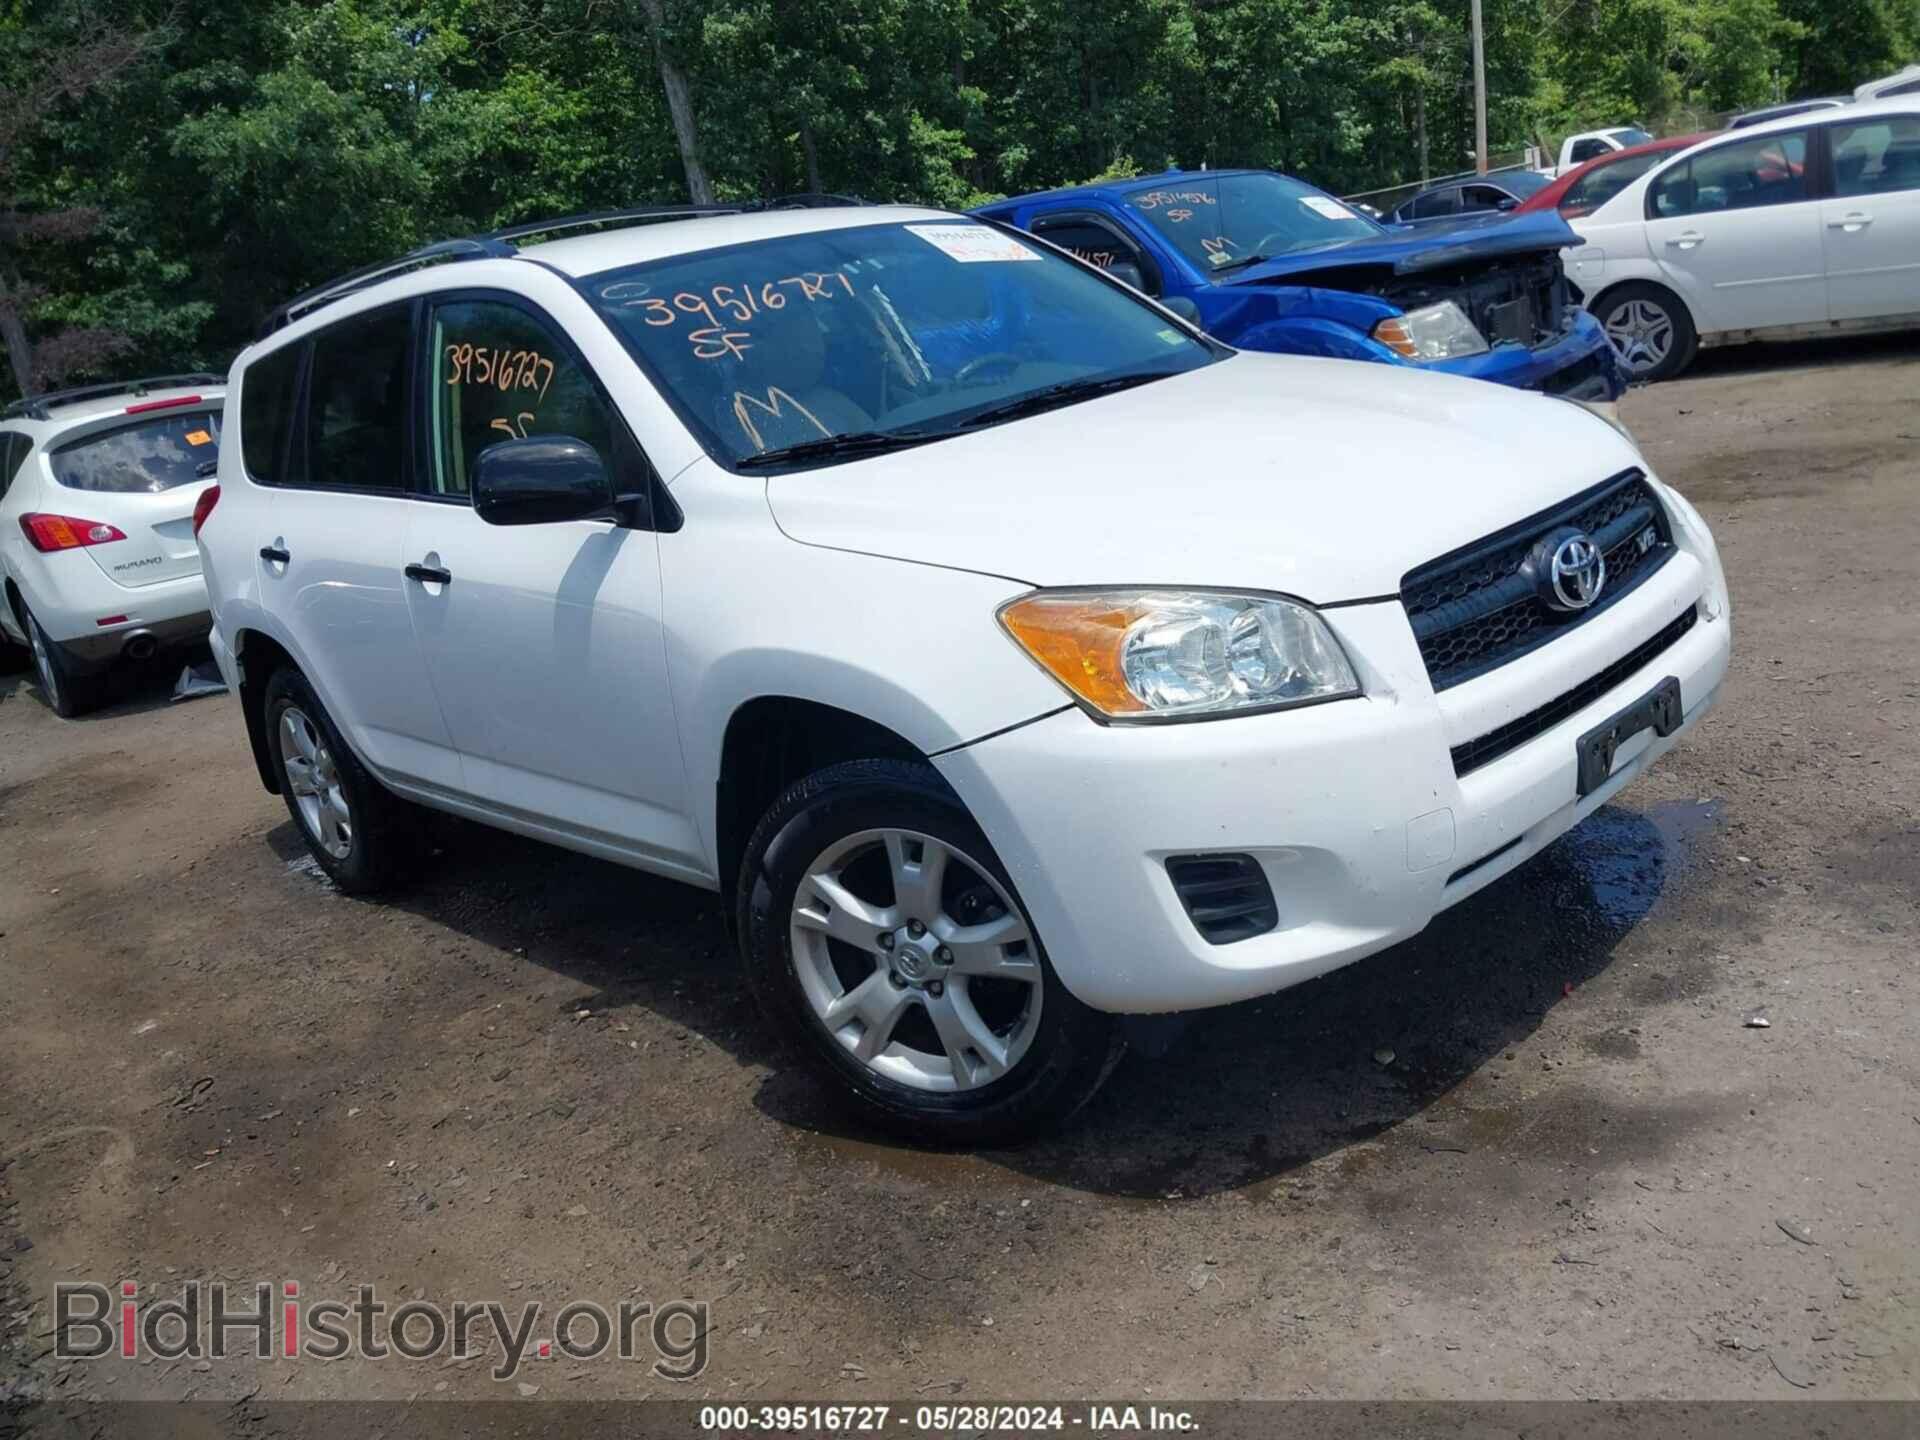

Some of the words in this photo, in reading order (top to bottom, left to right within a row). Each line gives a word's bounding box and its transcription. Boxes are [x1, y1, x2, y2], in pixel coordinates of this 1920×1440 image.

[1201, 236, 1239, 256] M
[689, 327, 752, 360] SF
[445, 344, 554, 403] 39516727
[733, 386, 833, 455] M
[113, 556, 163, 571] MURANO
